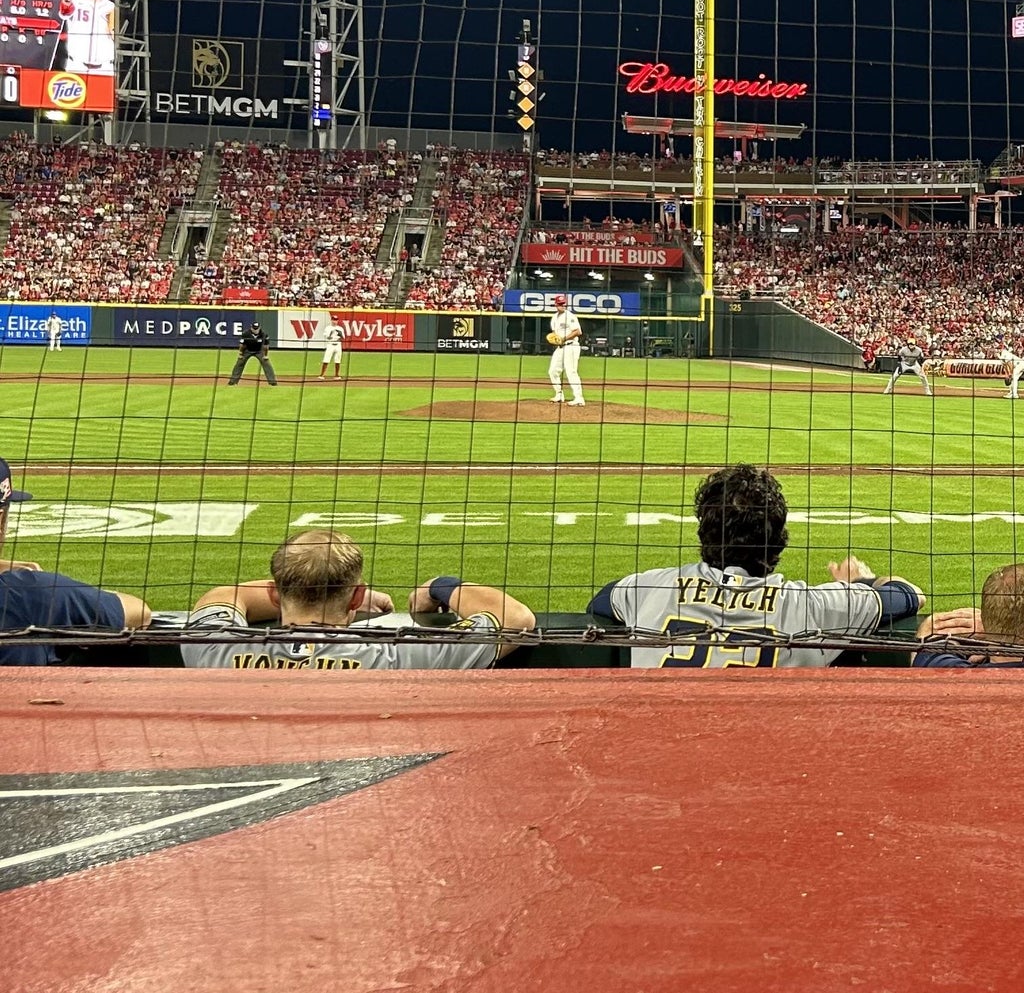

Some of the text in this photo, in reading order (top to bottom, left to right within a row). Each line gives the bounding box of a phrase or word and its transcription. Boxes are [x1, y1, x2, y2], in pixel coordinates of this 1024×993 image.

[77, 9, 90, 22] 15
[4, 76, 17, 102] 0
[619, 63, 807, 99] Budweiser
[53, 82, 82, 100] Tide
[155, 93, 278, 119] BETMGM
[569, 249, 666, 265] HIT THE BUDS
[520, 293, 621, 313] GEICO
[8, 316, 86, 331] Elizaeth
[124, 317, 243, 335] MEDPACE
[343, 319, 406, 341] Wyler
[437, 339, 489, 349] BETMGM
[950, 363, 984, 374] GORILLA
[677, 578, 780, 612] YELICH
